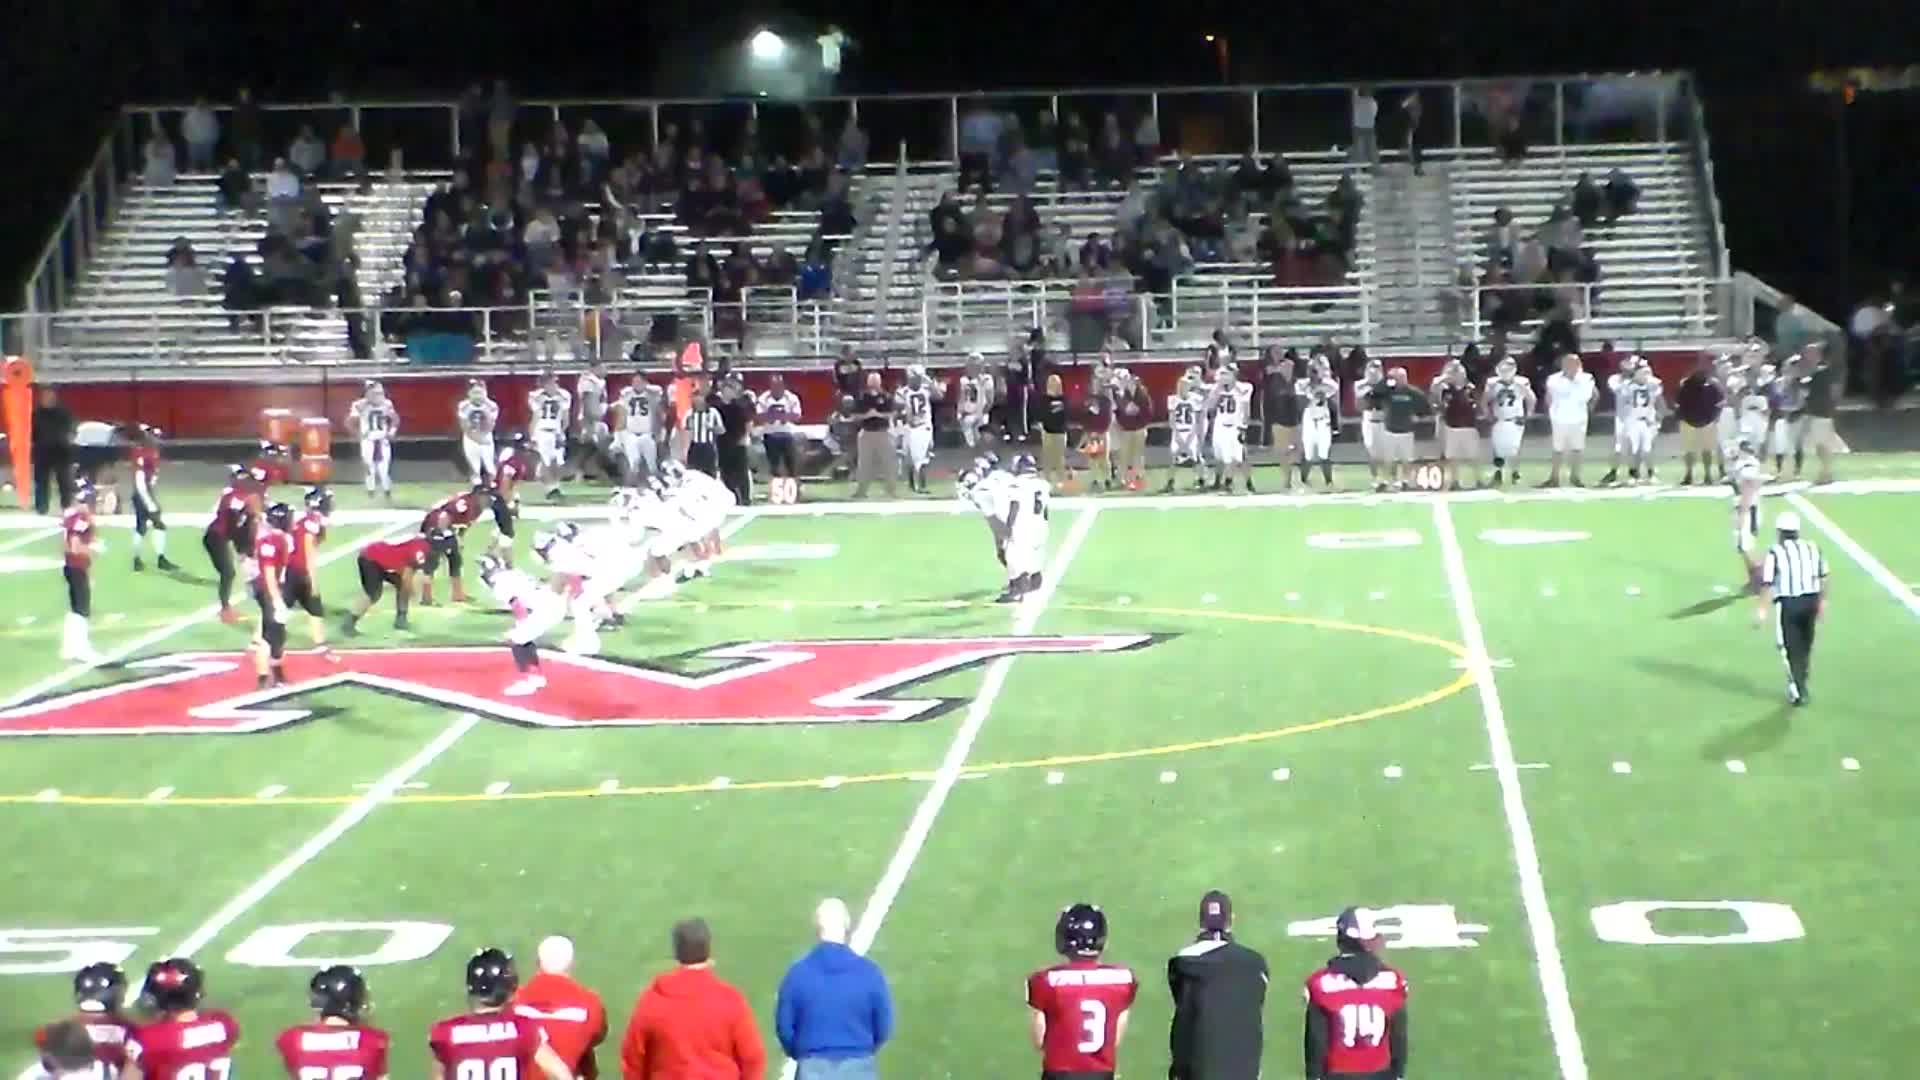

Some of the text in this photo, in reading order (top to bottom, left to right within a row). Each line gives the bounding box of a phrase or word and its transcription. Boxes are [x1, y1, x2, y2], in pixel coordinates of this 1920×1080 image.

[770, 477, 798, 504] 50
[1416, 465, 1442, 490] 40
[1077, 999, 1107, 1053] 3
[1340, 1003, 1386, 1048] 14
